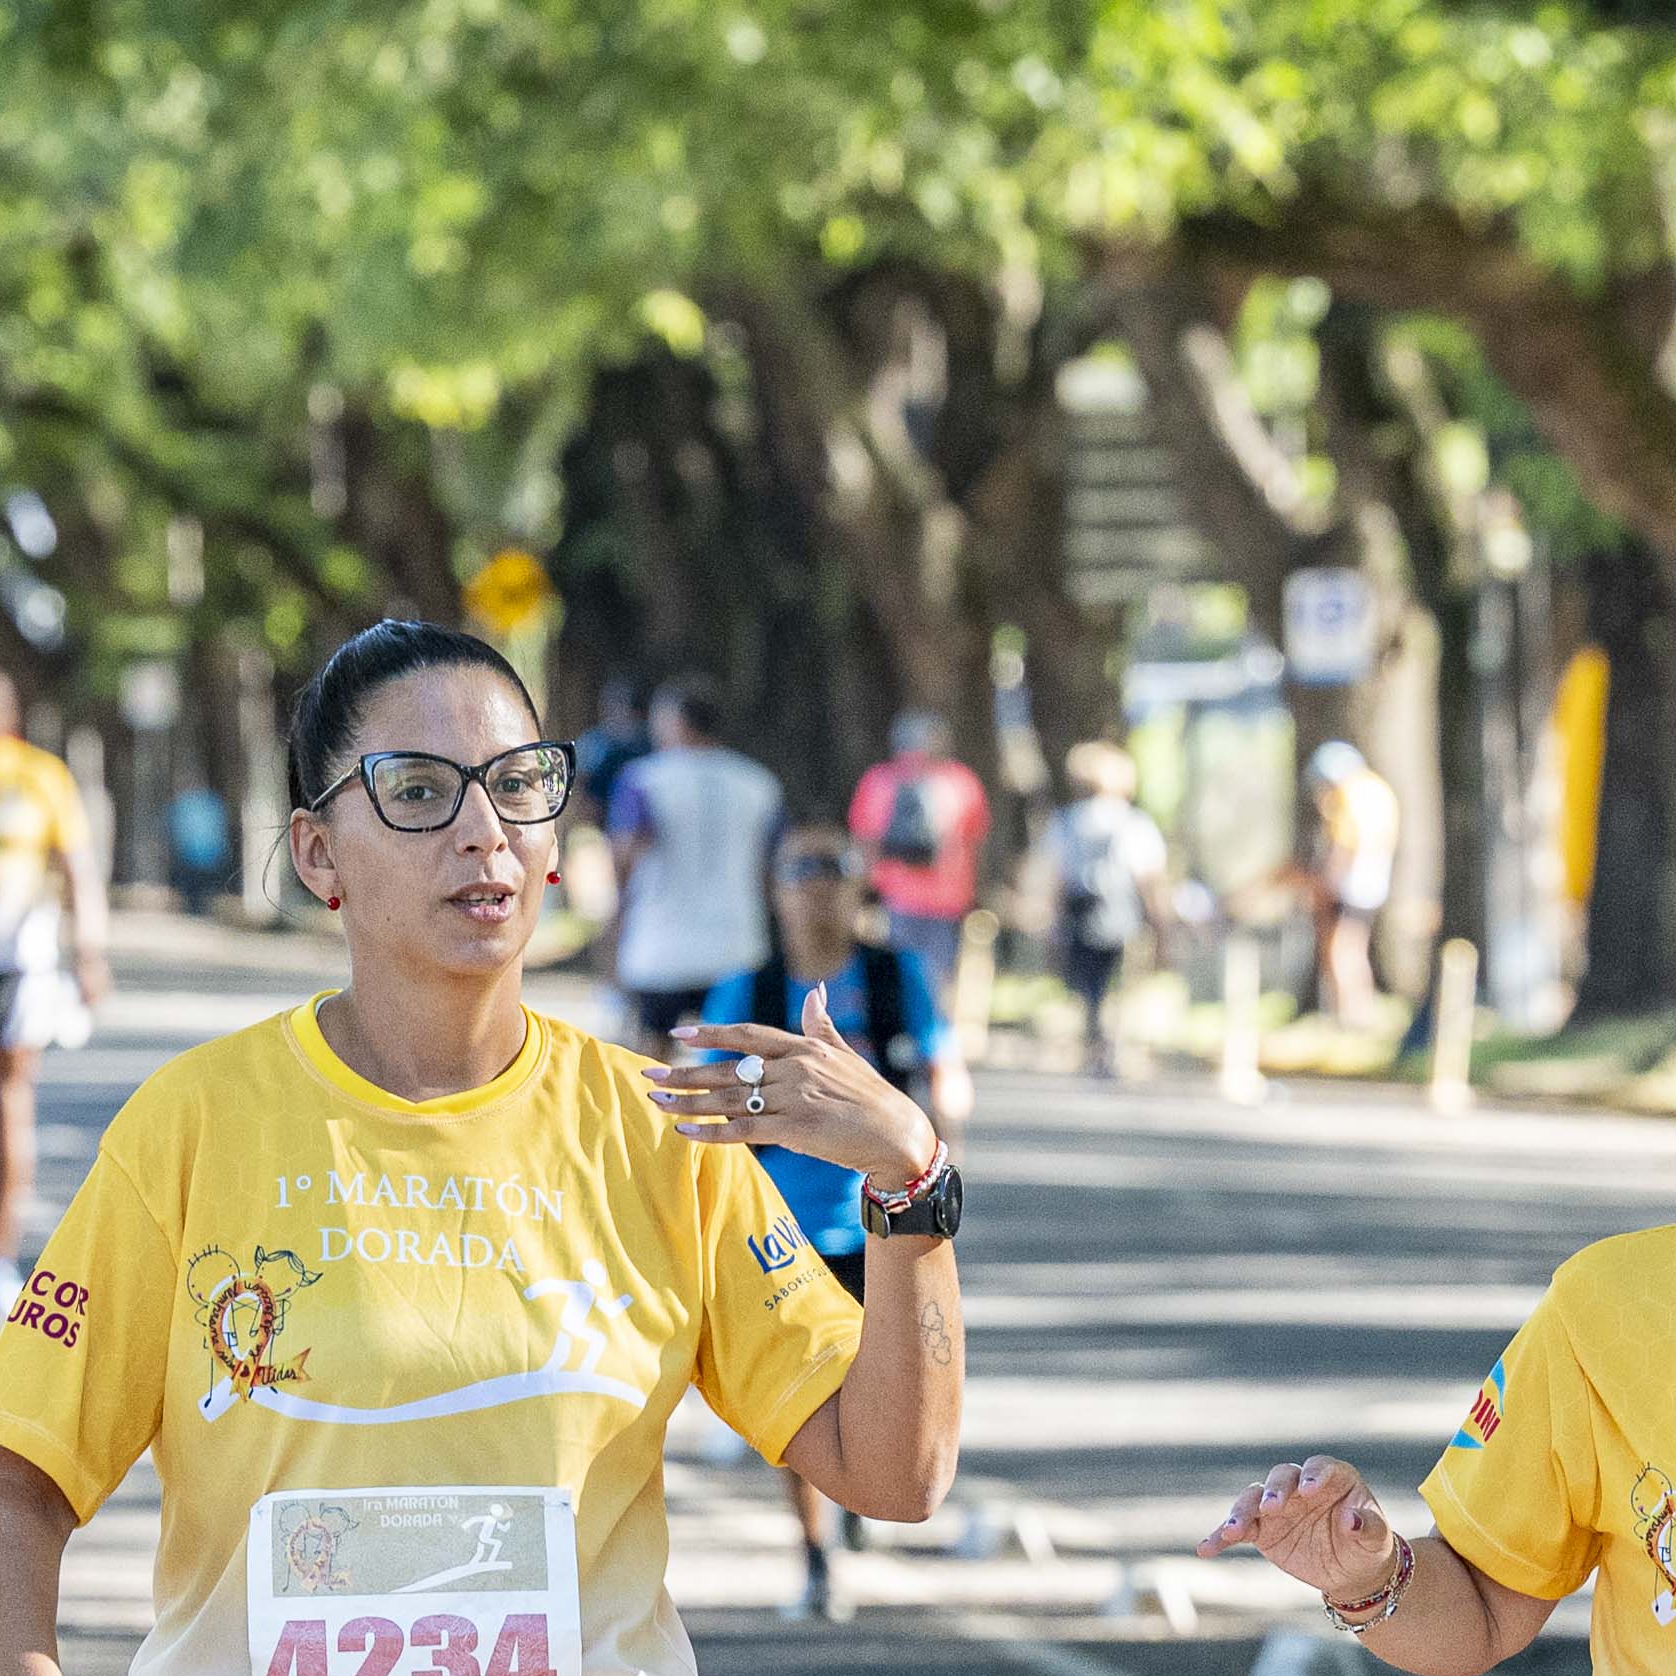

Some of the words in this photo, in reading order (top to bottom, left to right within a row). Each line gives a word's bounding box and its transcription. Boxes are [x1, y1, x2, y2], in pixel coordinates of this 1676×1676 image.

[326, 1170, 564, 1223] MARATÓN
[318, 1227, 525, 1273] DORADA
[22, 1268, 90, 1316] COR
[1470, 1388, 1501, 1443] INI
[380, 1513, 443, 1529] DORADA
